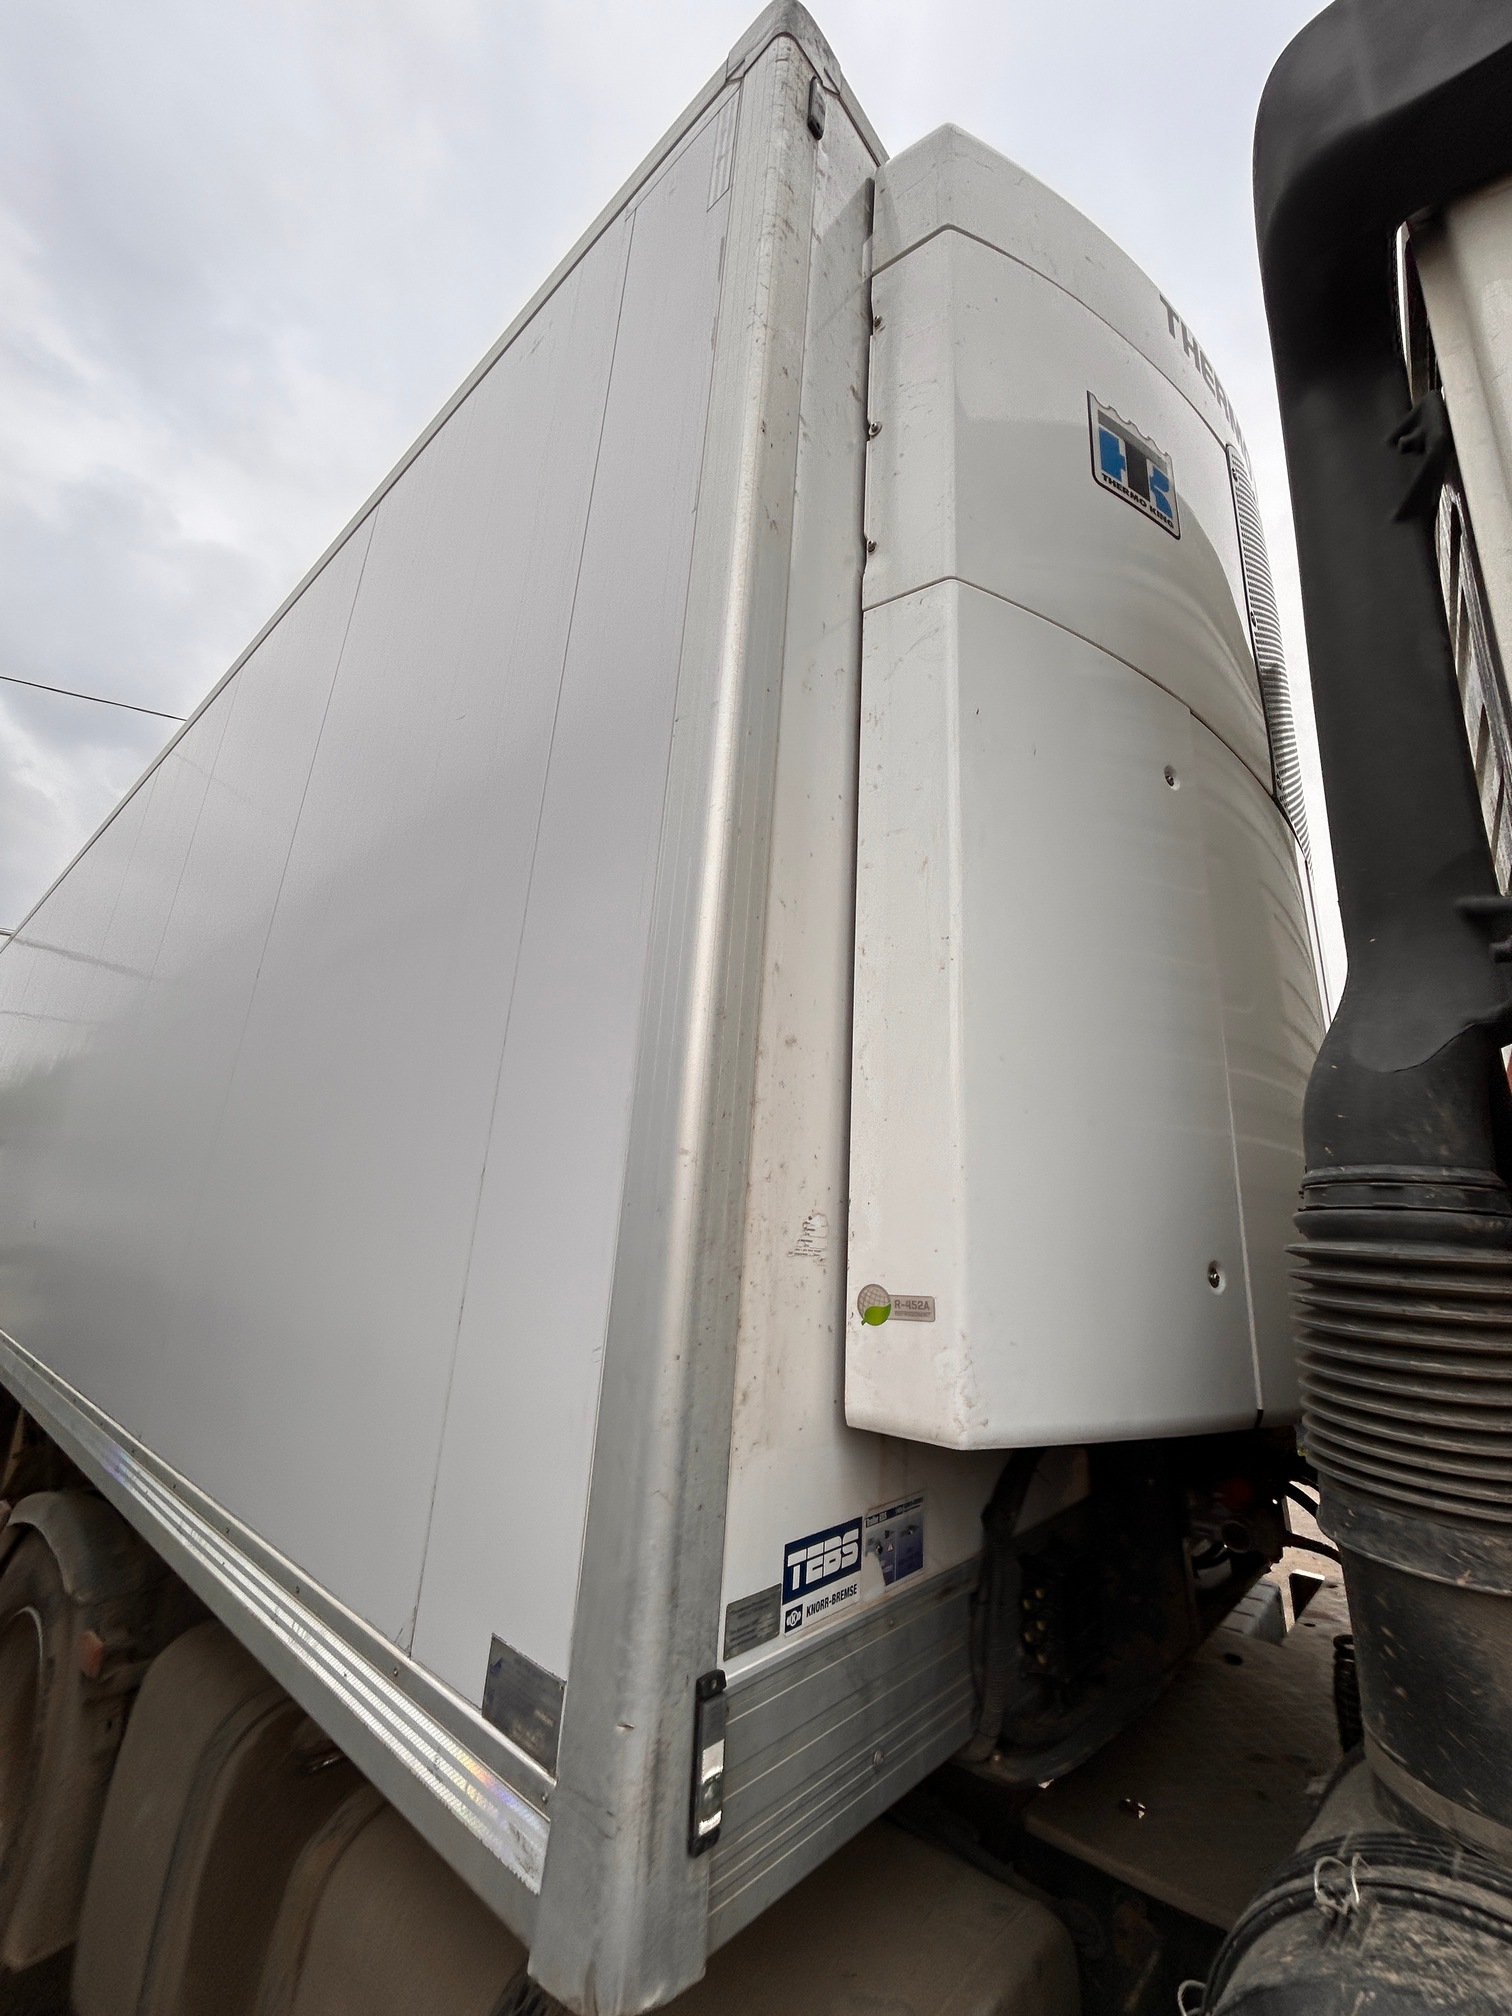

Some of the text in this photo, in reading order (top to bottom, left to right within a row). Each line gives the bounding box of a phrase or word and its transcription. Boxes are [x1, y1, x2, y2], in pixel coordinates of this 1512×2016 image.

[1101, 472, 1174, 529] THERMO KING
[894, 1300, 931, 1311] R-452A
[787, 1528, 859, 1591] TEBS
[806, 1584, 858, 1618] KNORR-BREMSE
